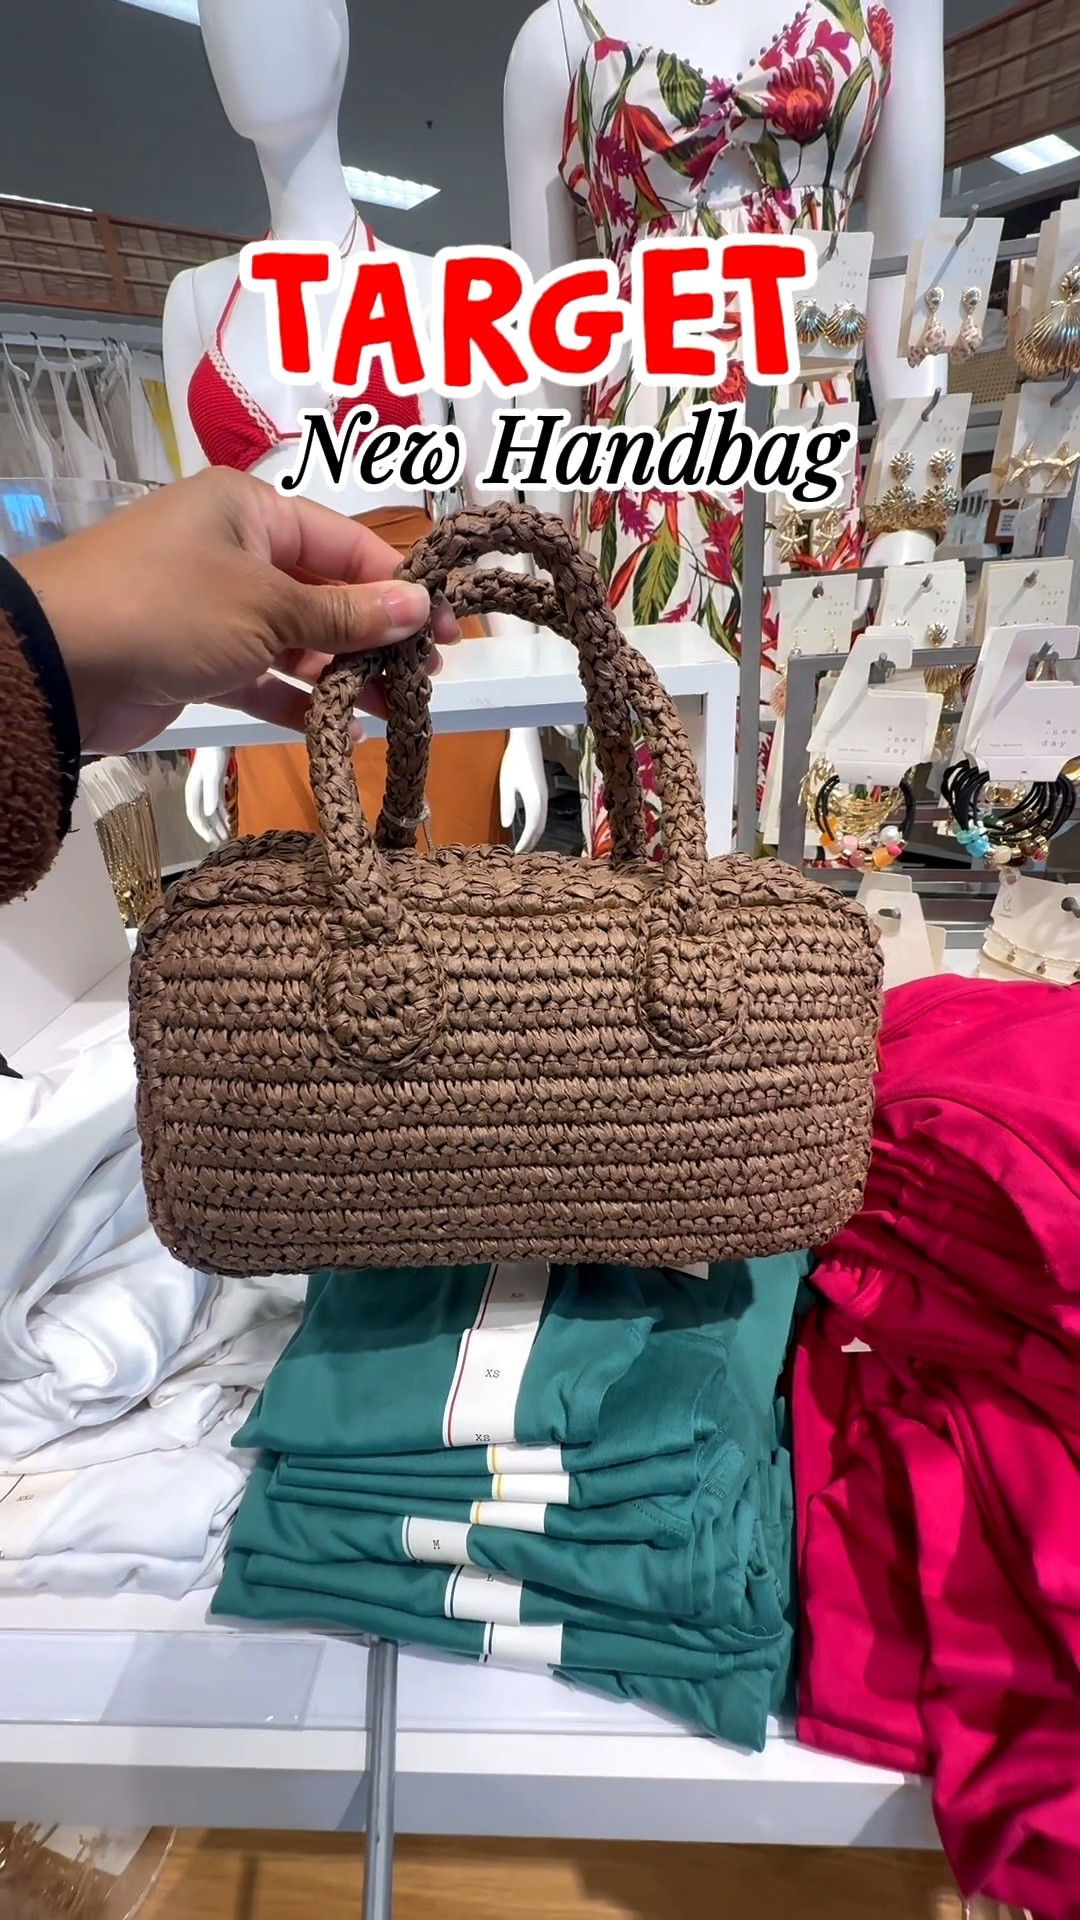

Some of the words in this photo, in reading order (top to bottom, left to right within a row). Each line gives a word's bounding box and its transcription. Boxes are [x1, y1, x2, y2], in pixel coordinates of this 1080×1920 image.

[485, 1368, 501, 1379] XS
[475, 1433, 491, 1442] XS
[432, 1539, 441, 1550] M
